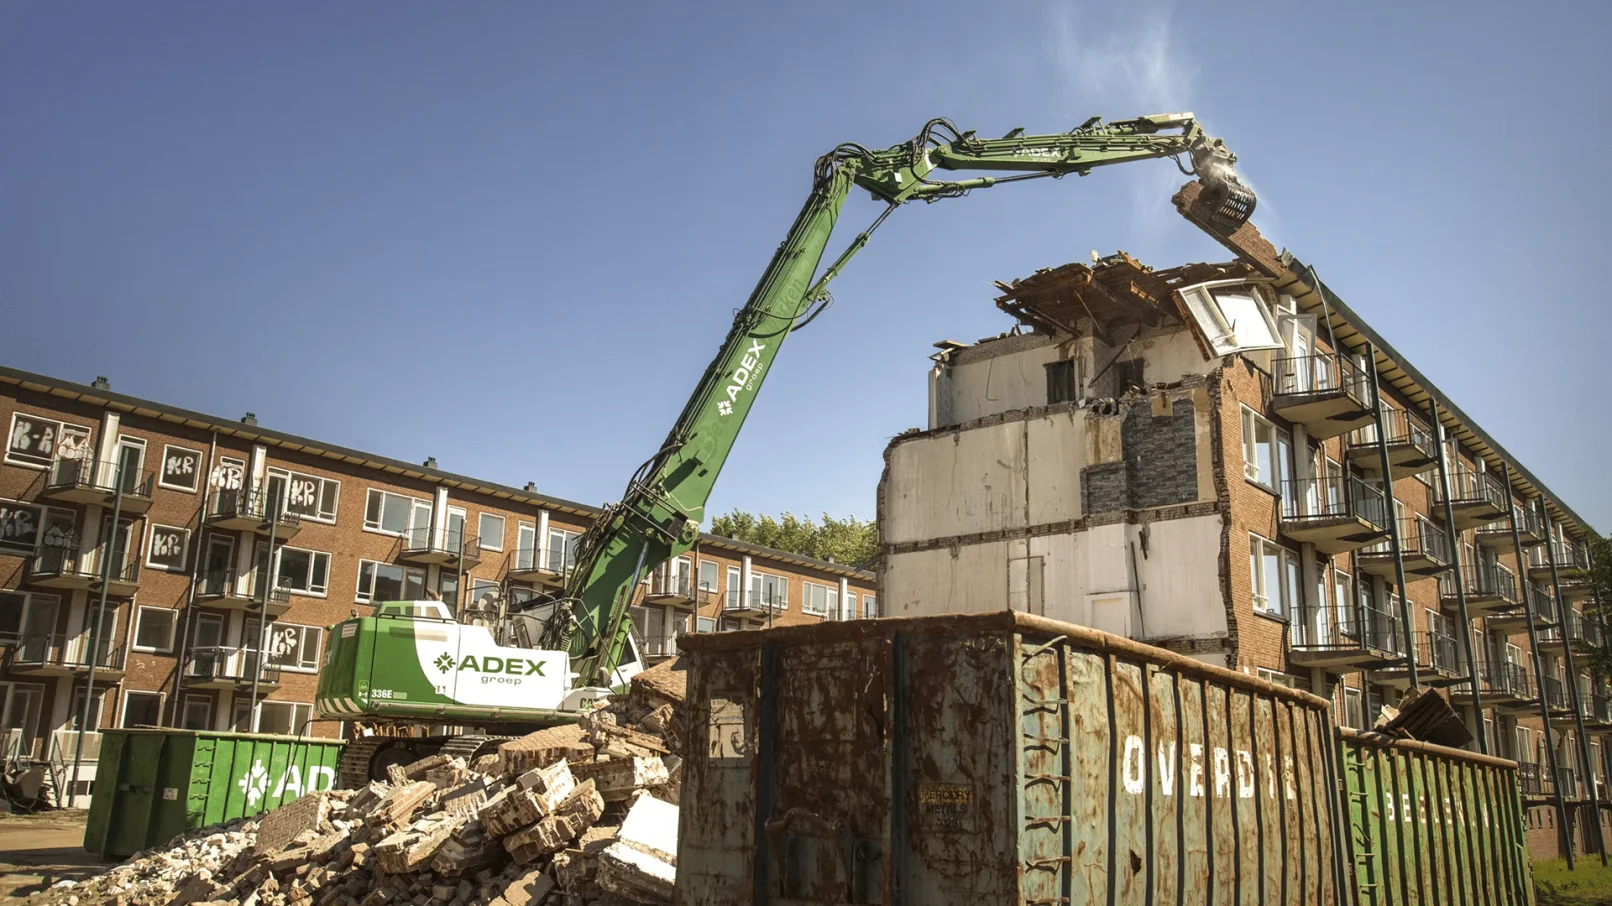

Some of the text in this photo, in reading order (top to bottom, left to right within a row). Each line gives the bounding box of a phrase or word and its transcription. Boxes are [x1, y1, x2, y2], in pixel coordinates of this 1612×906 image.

[1021, 147, 1061, 158] ADEX
[726, 338, 766, 403] ADEX
[746, 362, 764, 391] groep
[457, 655, 547, 677] ADEX
[481, 676, 522, 686] groep
[371, 689, 393, 699] 336E
